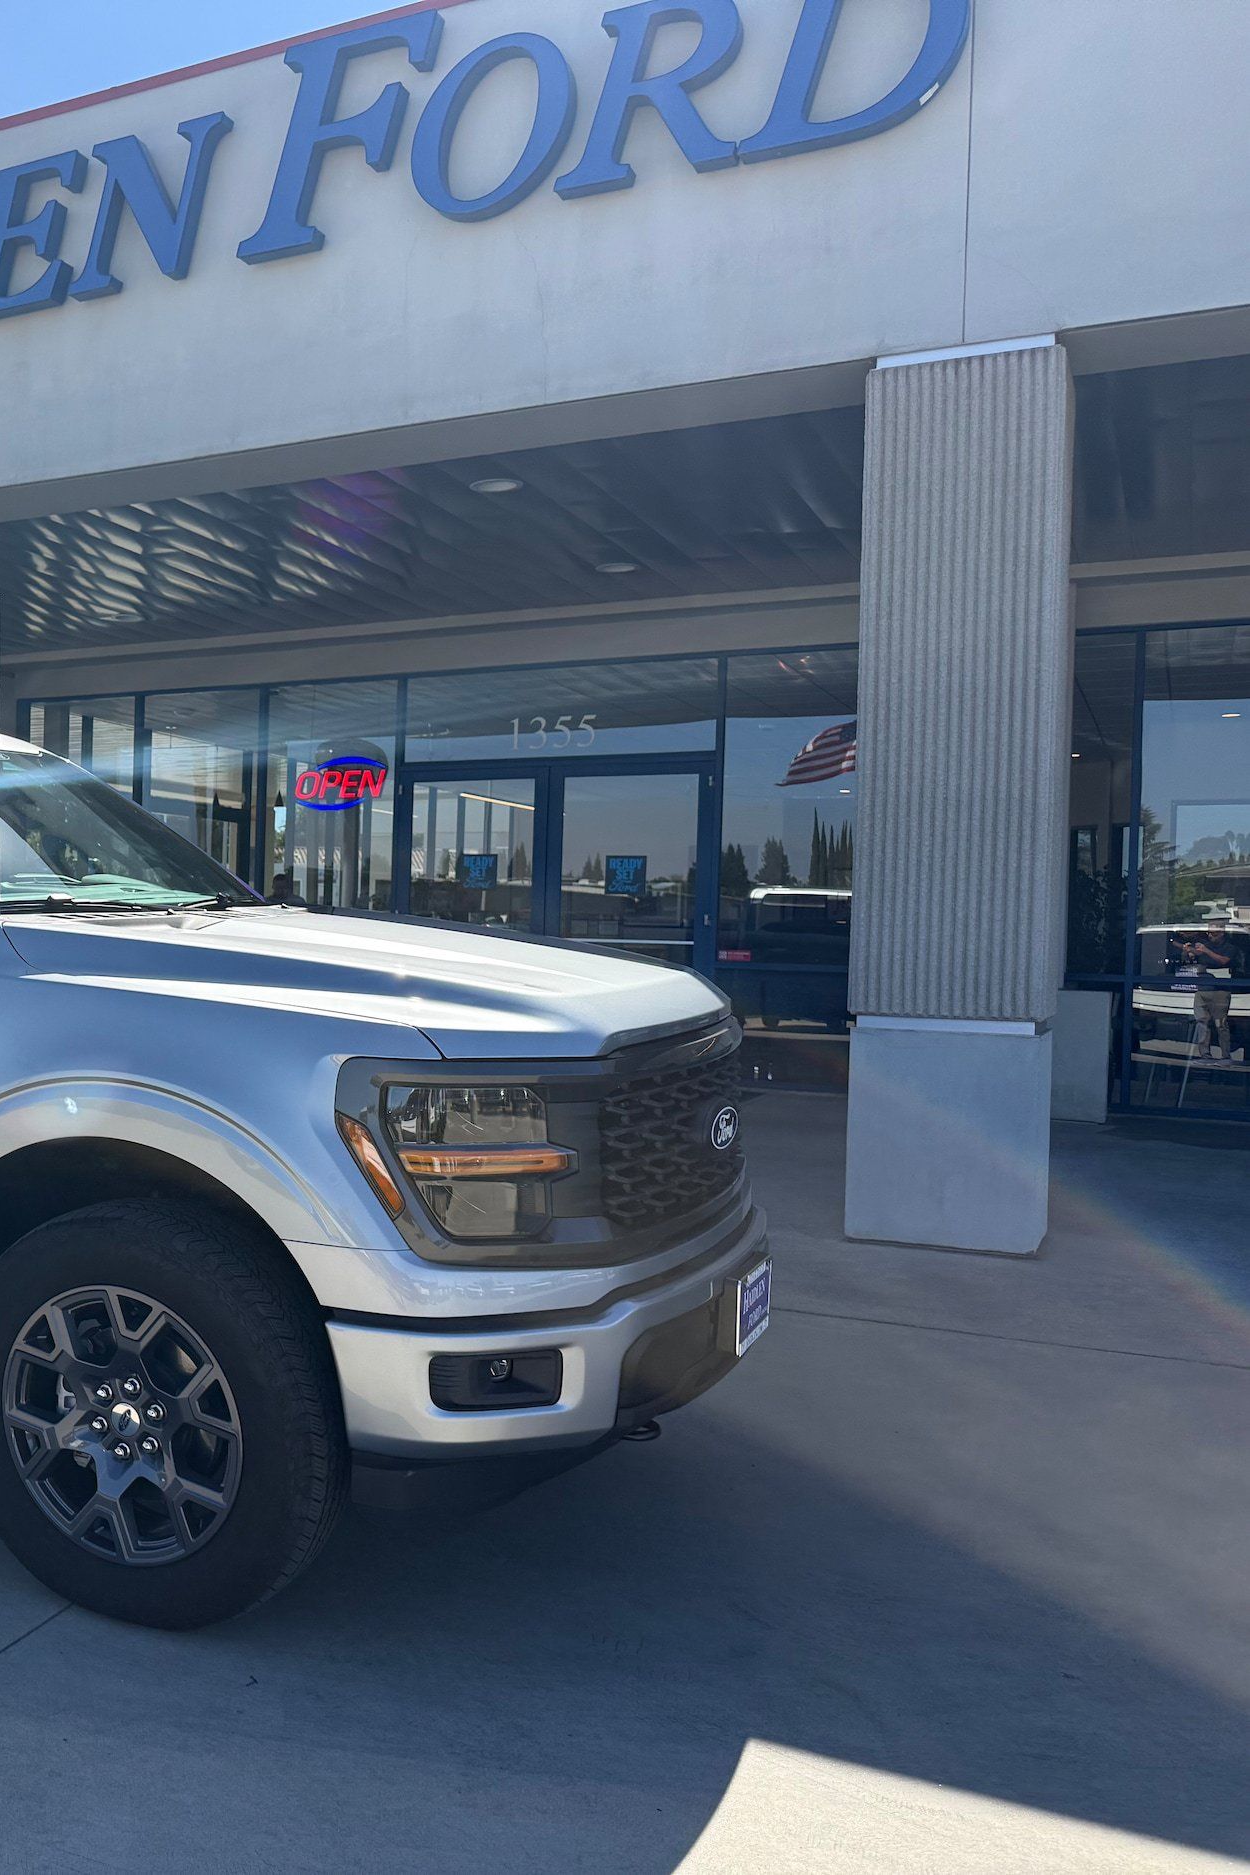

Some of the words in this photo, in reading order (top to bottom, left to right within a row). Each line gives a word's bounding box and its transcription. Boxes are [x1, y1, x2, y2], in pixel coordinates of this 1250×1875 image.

[236, 0, 971, 266] FORD
[510, 714, 597, 752] 1355
[295, 768, 387, 800] OPEN
[609, 858, 642, 870] READY
[615, 870, 634, 881] SET
